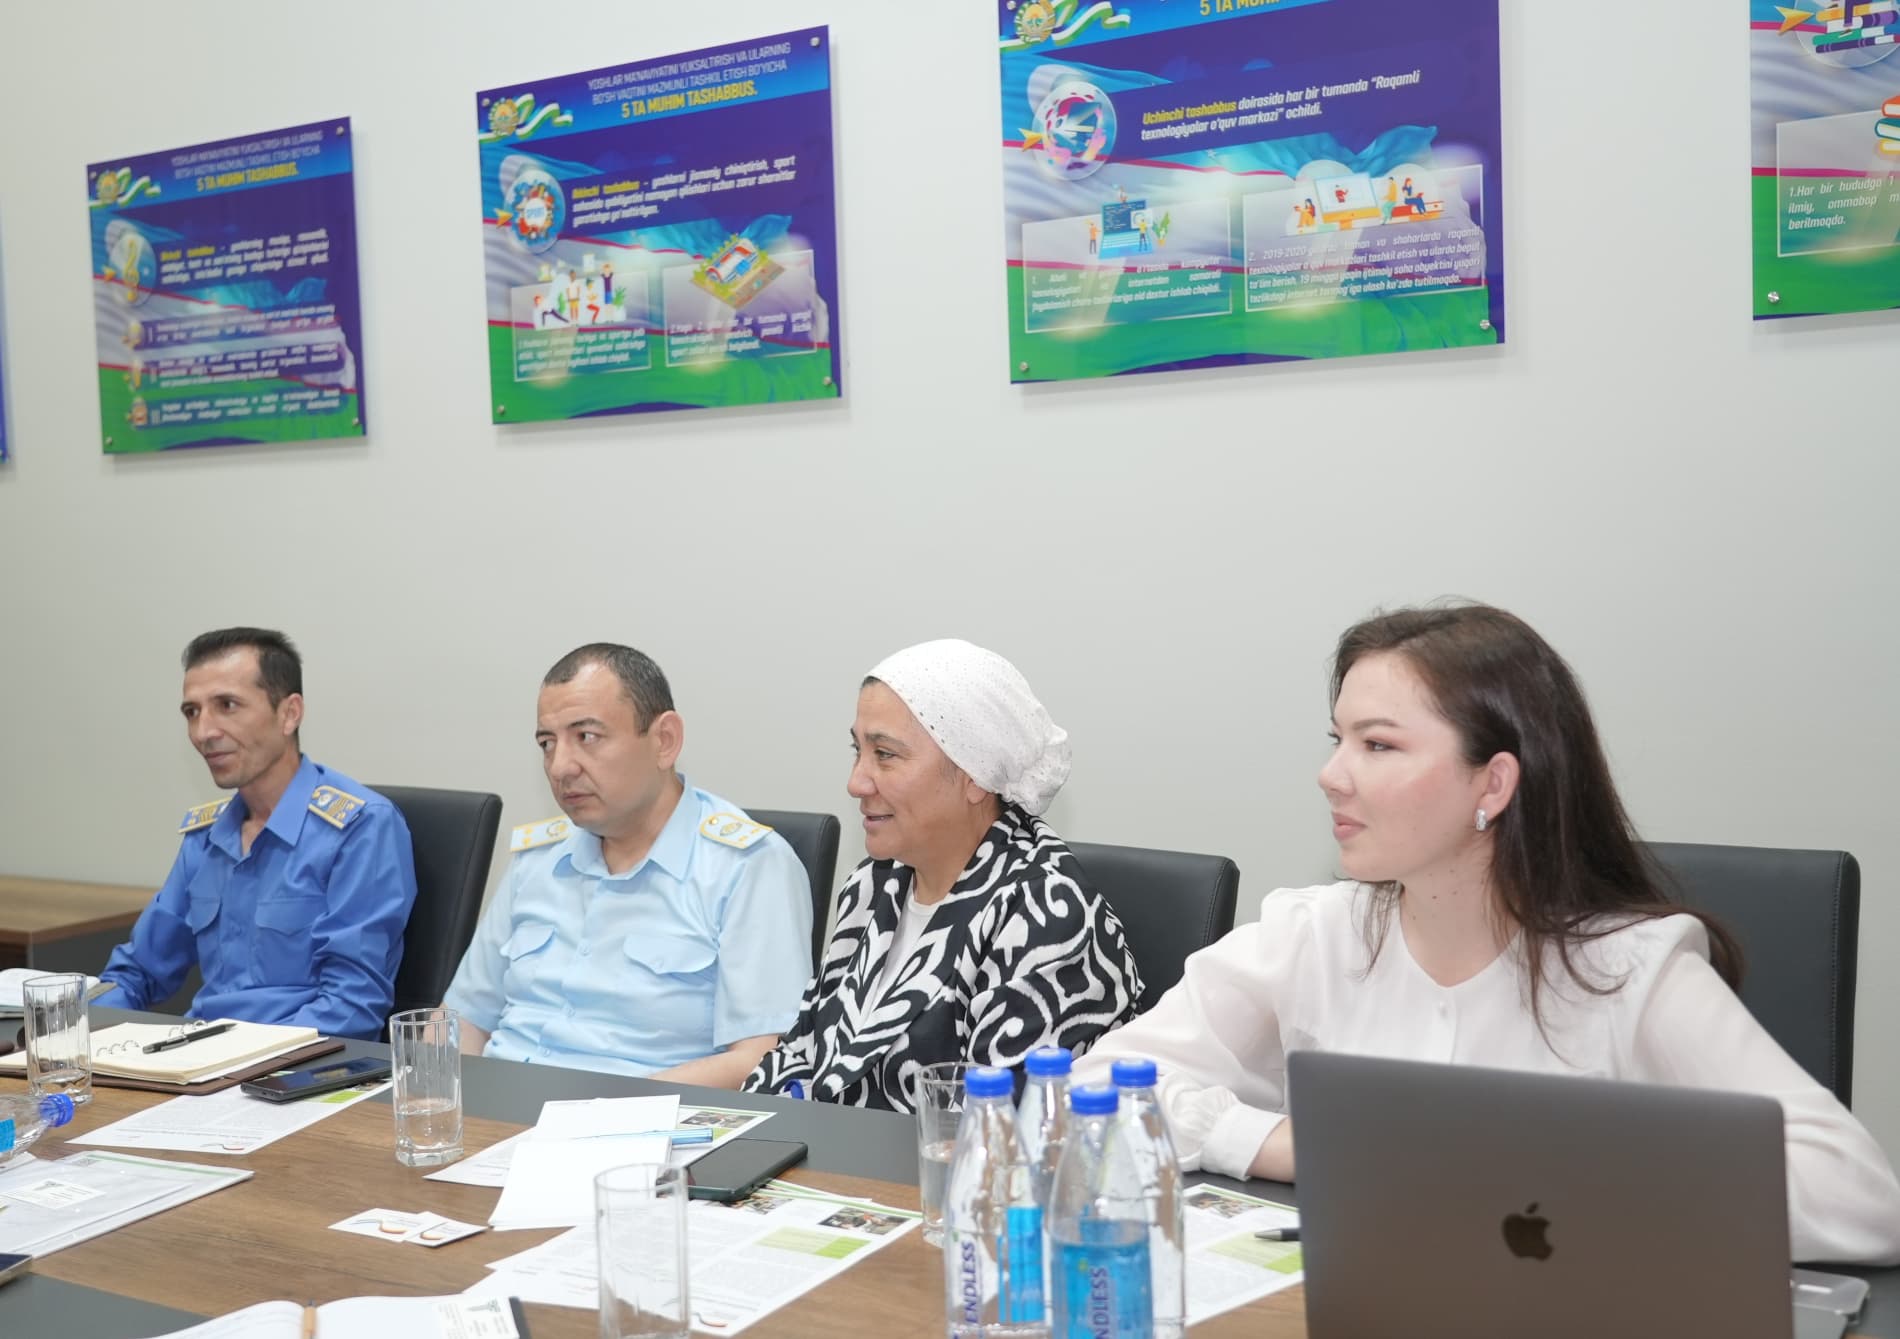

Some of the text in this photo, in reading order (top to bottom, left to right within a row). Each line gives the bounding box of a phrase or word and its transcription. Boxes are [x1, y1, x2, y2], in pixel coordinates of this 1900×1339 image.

[621, 79, 758, 119] 5 TA MUHIM TASHABBUS.
[1143, 107, 1185, 125] Uchinchi
[1186, 101, 1237, 118] tashabbus
[1238, 92, 1284, 110] doirasida
[1285, 90, 1304, 103] har
[1305, 86, 1320, 101] bir
[1322, 79, 1368, 97] tumanda
[1141, 120, 1209, 140] texnologiyalar
[1285, 102, 1322, 119] ochildi.
[1820, 182, 1834, 194] bir
[1839, 178, 1882, 192] hududga
[1827, 195, 1877, 209] ommabop
[1788, 214, 1846, 231] berilmoqda.
[1368, 251, 1396, 262] tashkil
[1396, 248, 1417, 259] etish
[1418, 248, 1428, 257] va
[1394, 264, 1413, 275] soha
[962, 1240, 978, 1324] ENDLESS
[1091, 1266, 1110, 1339] NDLESS
